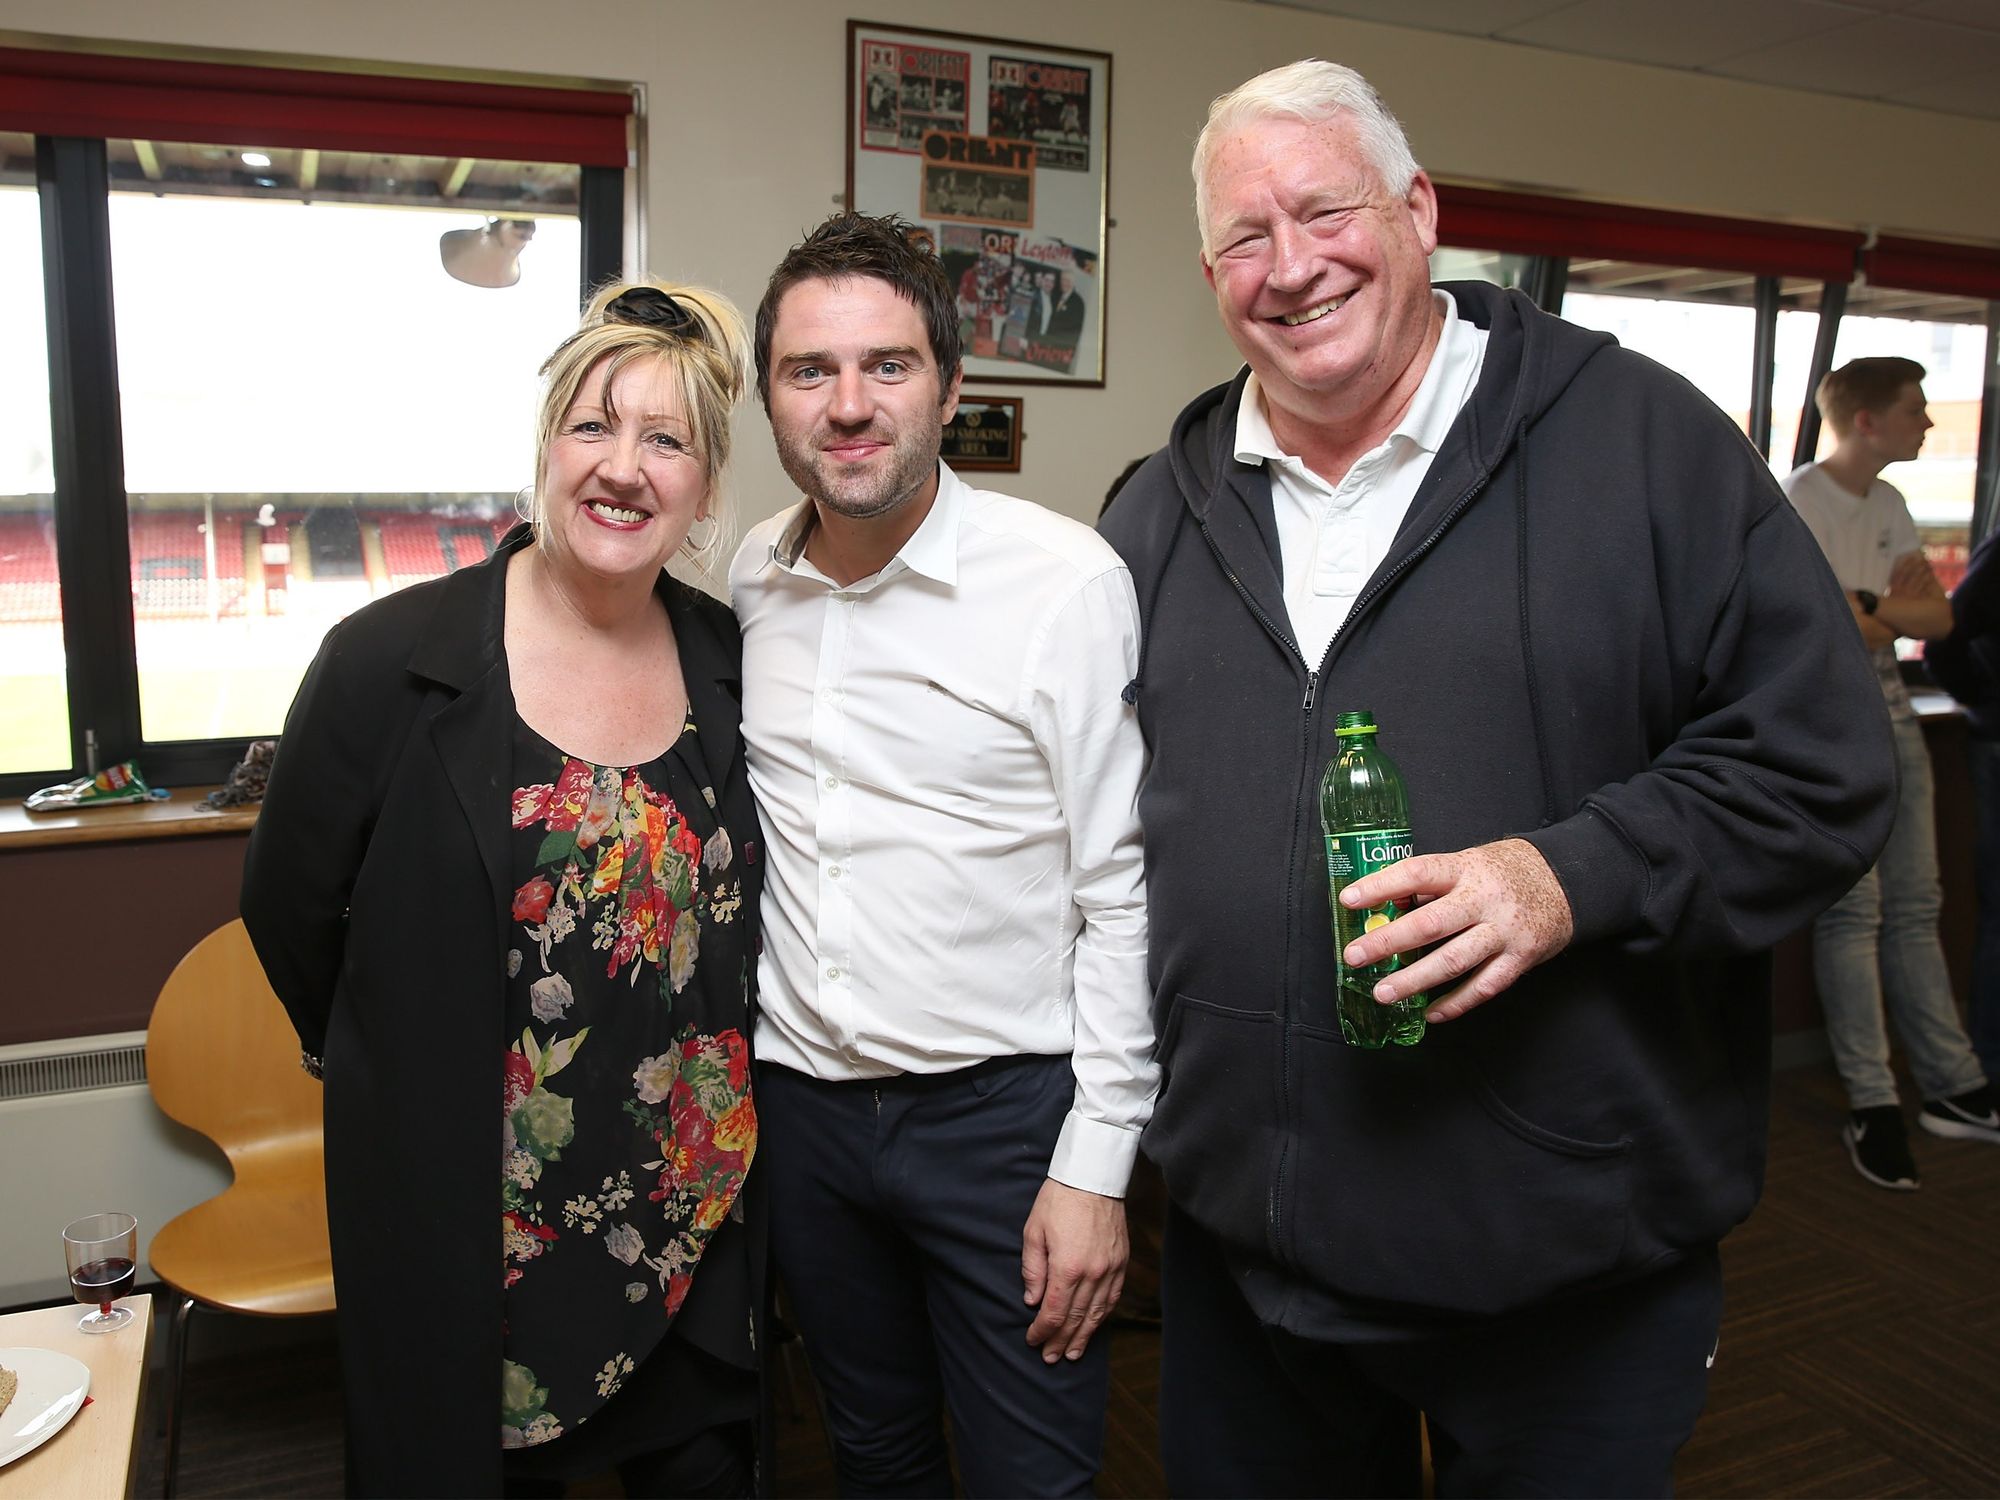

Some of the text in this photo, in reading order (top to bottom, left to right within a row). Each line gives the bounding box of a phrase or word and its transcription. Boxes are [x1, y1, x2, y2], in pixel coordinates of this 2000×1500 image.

[899, 48, 967, 79] ORIENT
[1024, 64, 1089, 95] ORIENT
[925, 133, 1034, 171] ORIENT
[1021, 237, 1073, 262] Leyton
[1024, 339, 1075, 364] Orient
[958, 428, 1009, 442] SMOKING
[960, 441, 988, 455] AREA
